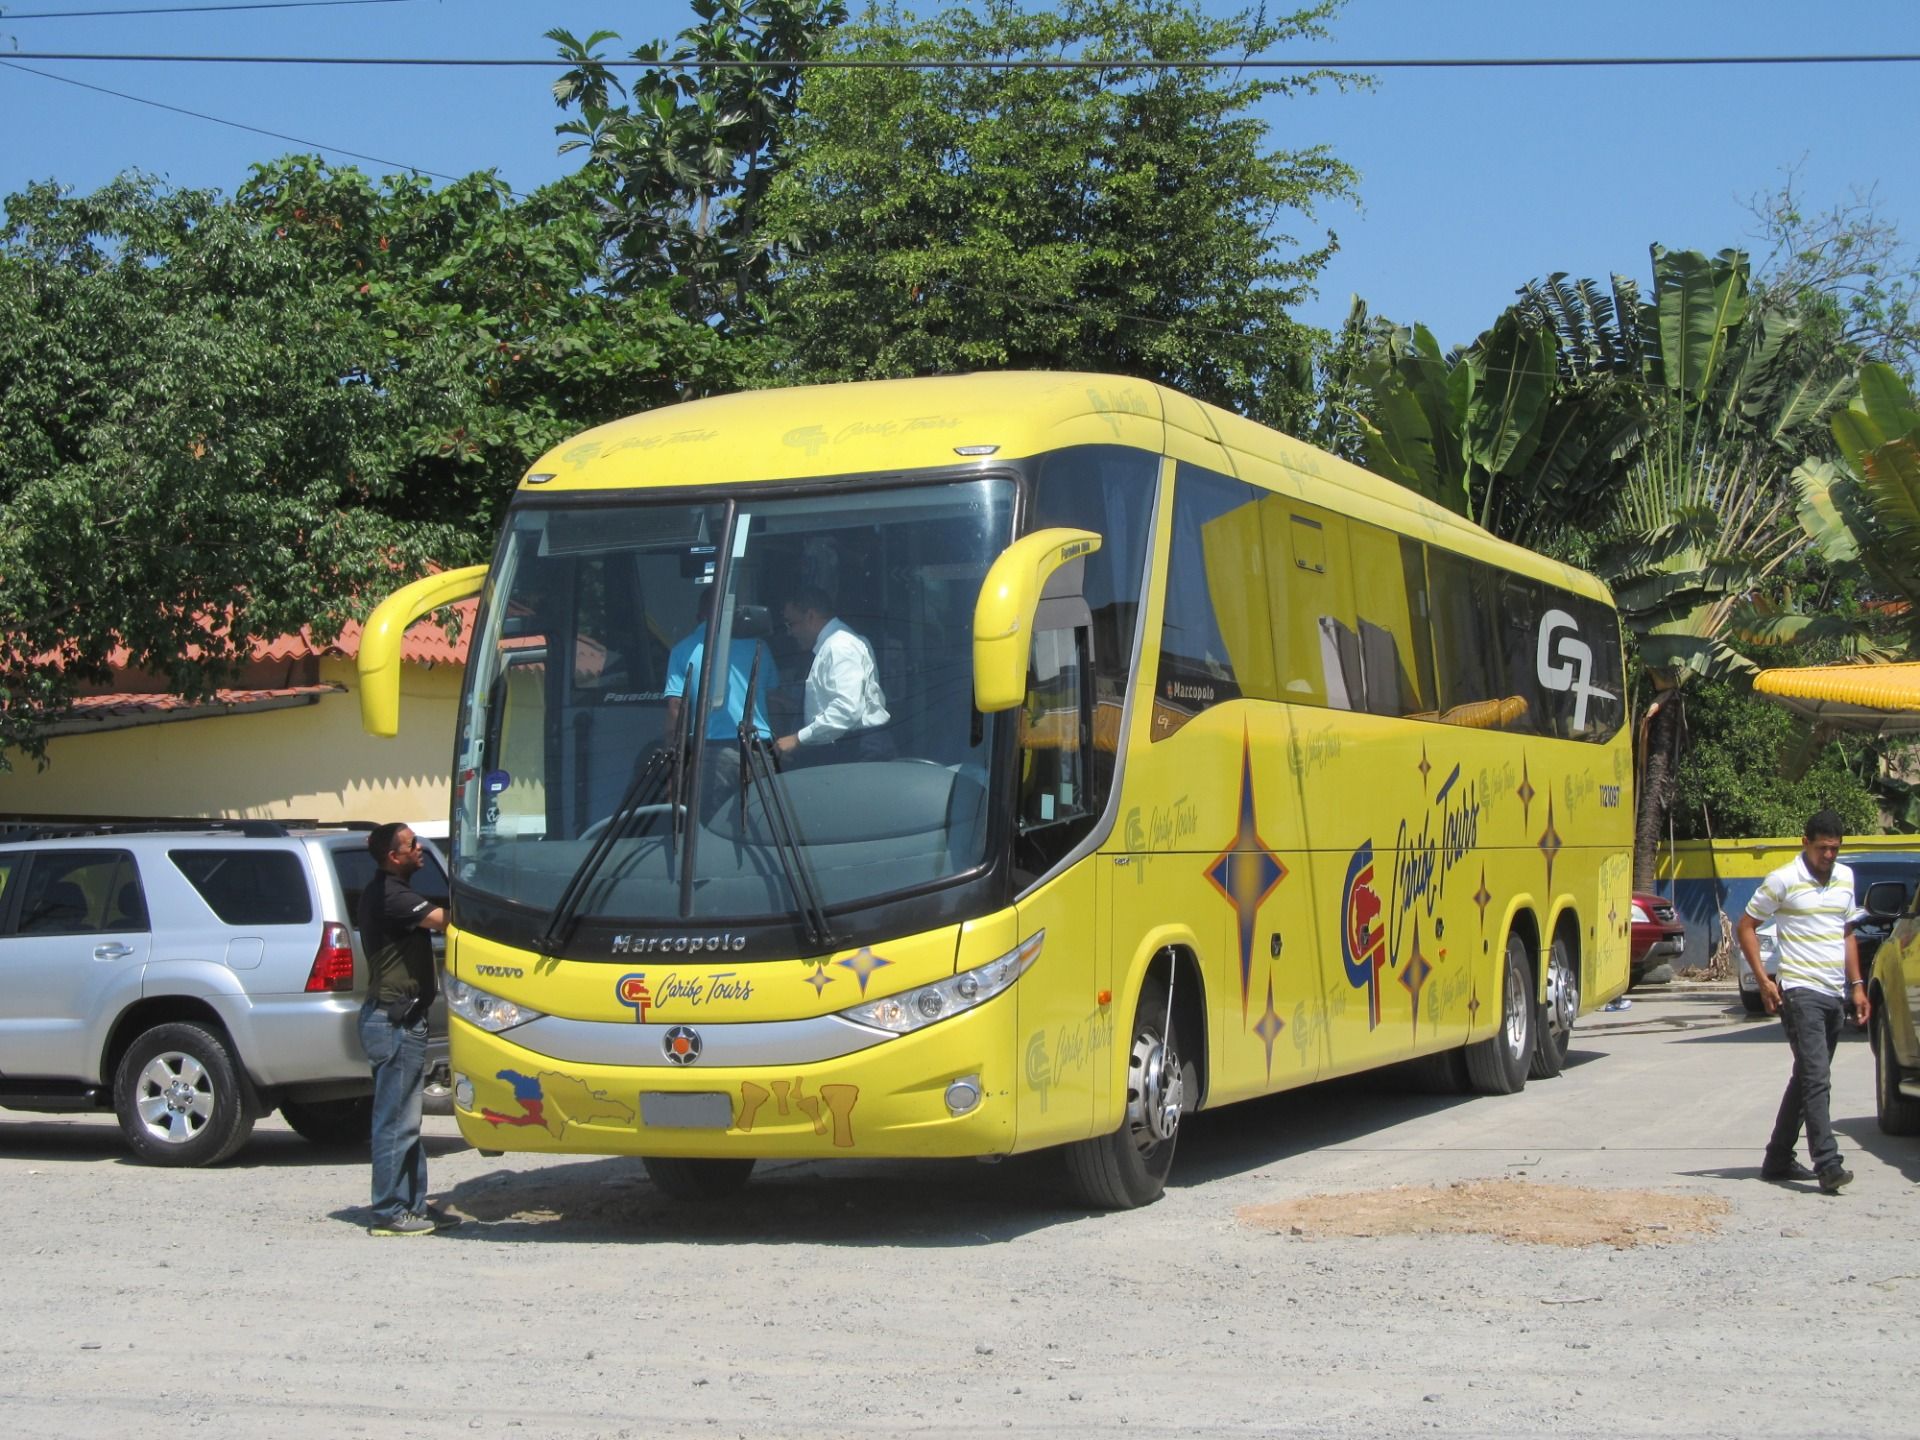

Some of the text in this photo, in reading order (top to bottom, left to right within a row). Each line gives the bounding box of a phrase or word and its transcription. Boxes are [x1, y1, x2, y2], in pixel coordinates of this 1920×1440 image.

[1173, 681, 1215, 701] Marcopolo
[1389, 807, 1438, 968] Caribe
[1436, 762, 1480, 900] Tours
[611, 933, 746, 953] Marcopolo
[476, 964, 524, 978] VOLVO
[655, 973, 704, 1008] Caribe
[705, 972, 755, 1005] Tours
